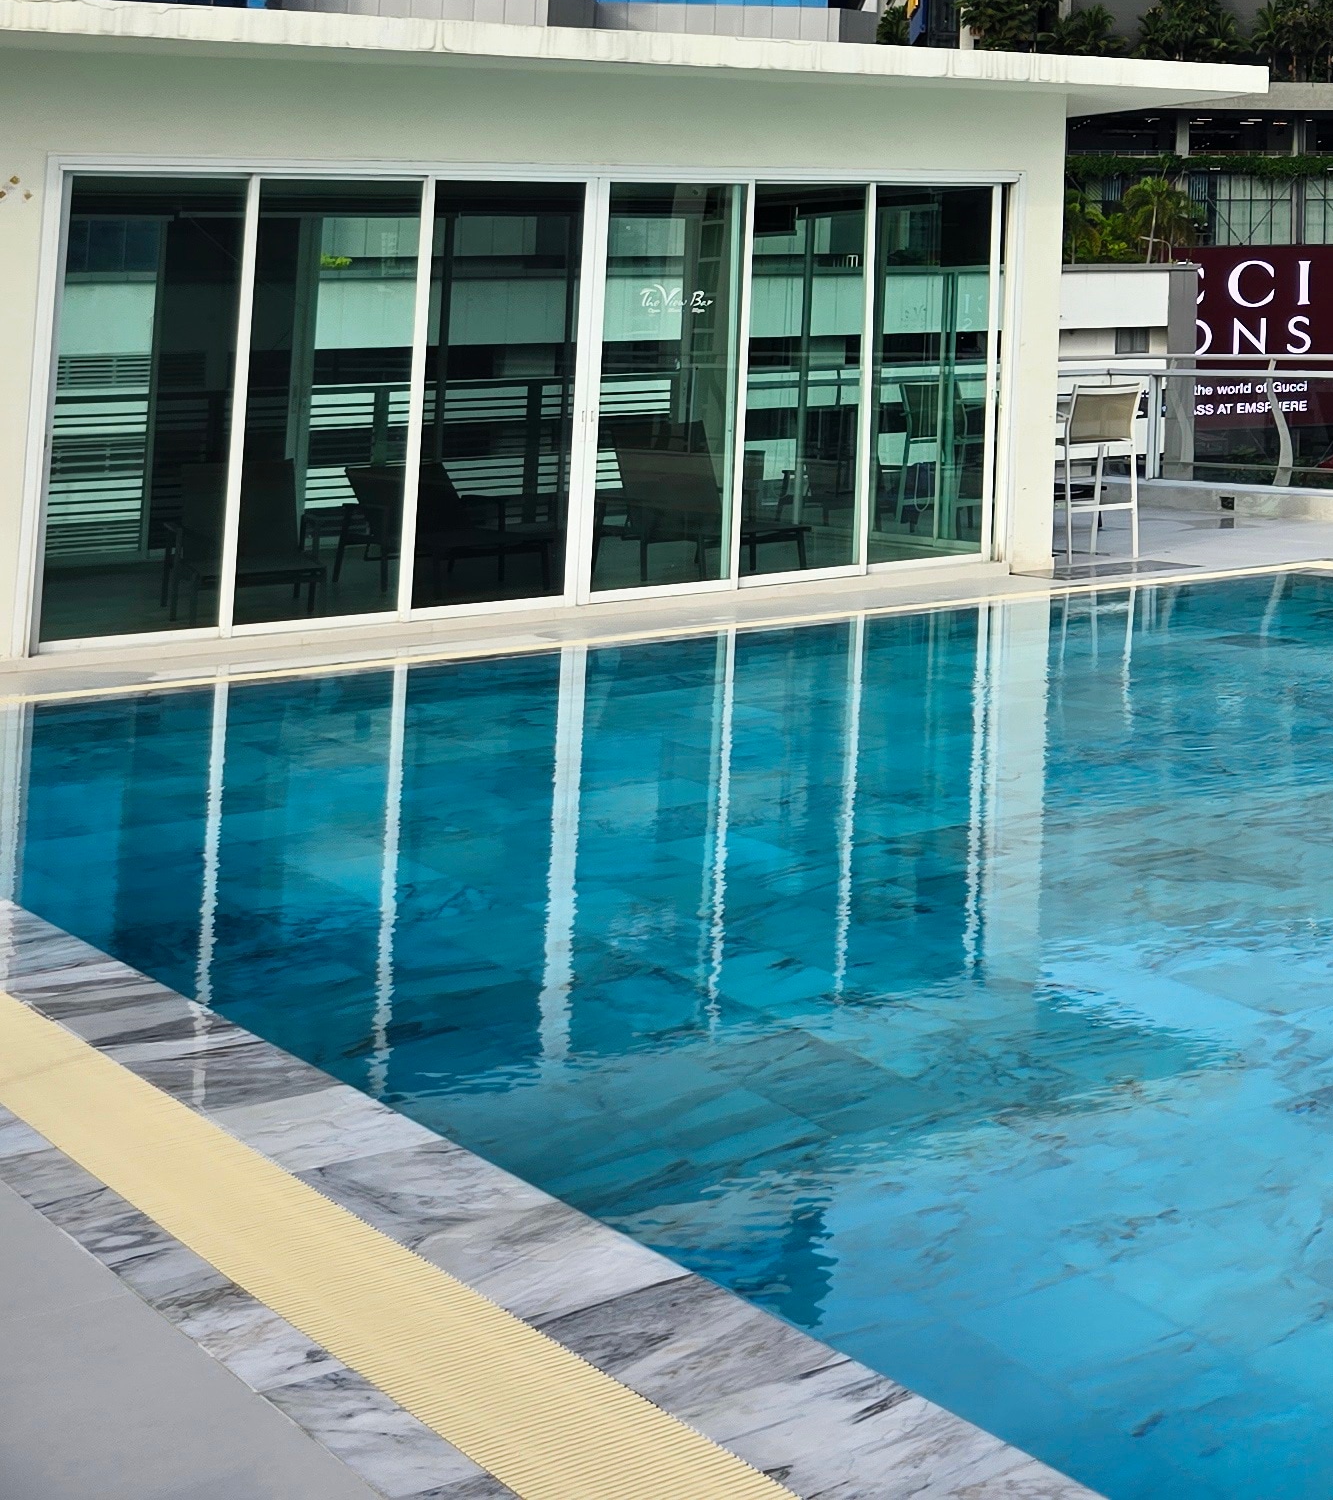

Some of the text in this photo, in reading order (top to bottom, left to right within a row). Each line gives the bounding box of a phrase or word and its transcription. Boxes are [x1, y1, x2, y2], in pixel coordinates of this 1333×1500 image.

[1196, 260, 1312, 308] CI
[654, 284, 687, 306] View
[690, 291, 713, 307] Bar
[1194, 381, 1307, 396] the world of Gucci
[1194, 400, 1307, 416] SS AT EMSPERE
